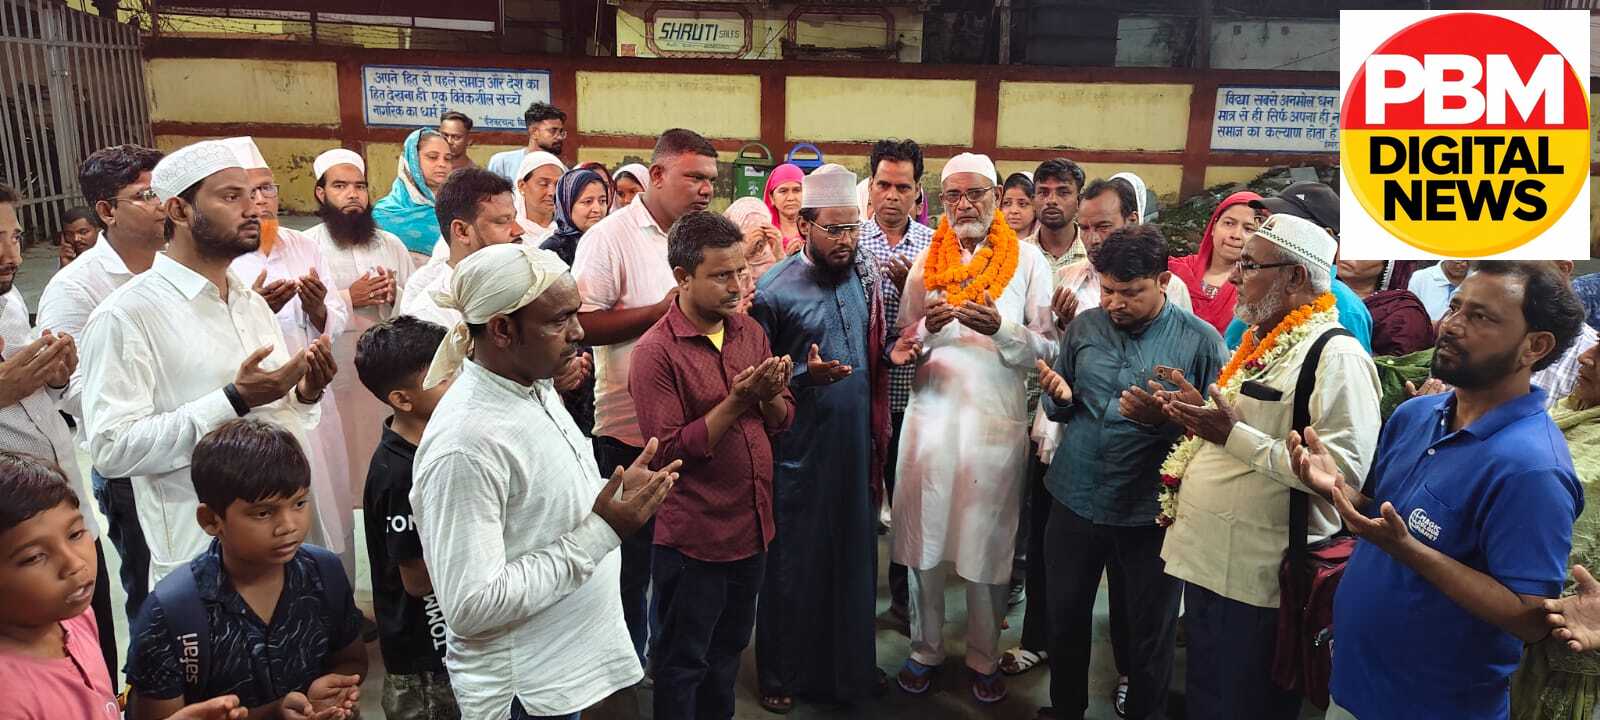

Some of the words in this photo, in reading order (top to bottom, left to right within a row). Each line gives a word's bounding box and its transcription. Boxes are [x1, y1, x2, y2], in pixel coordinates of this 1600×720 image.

[659, 22, 719, 41] SHRUTI
[375, 70, 399, 84] अपने
[401, 70, 419, 86] हित
[421, 71, 433, 86] से
[434, 71, 456, 87] पहले
[459, 76, 486, 89] समाज
[488, 73, 504, 90] और
[506, 74, 523, 92] देश
[526, 79, 540, 90] का
[369, 86, 386, 100] हित
[387, 85, 415, 102] देखना
[415, 86, 428, 101] ही
[430, 91, 448, 103] एक
[451, 88, 494, 106] विवेकशील
[496, 91, 522, 105] सच्चे
[1225, 90, 1251, 106] विद्या
[1254, 91, 1278, 106] सबसे
[1280, 91, 1315, 107] अनमोल
[1317, 95, 1336, 107] धन
[373, 101, 405, 118] नागरिक
[406, 106, 418, 117] का
[421, 104, 437, 117] धर्म
[1218, 110, 1236, 121] मात्र
[1239, 107, 1249, 122] से
[1251, 107, 1264, 122] ही
[1267, 108, 1288, 123] सिर्फ
[1290, 111, 1316, 122] अपना
[1319, 108, 1331, 123] ही
[1217, 126, 1245, 137] समाज
[1247, 126, 1262, 138] का
[1265, 126, 1302, 138] कल्याण
[1305, 124, 1327, 140] होता
[177, 633, 200, 685] safari
